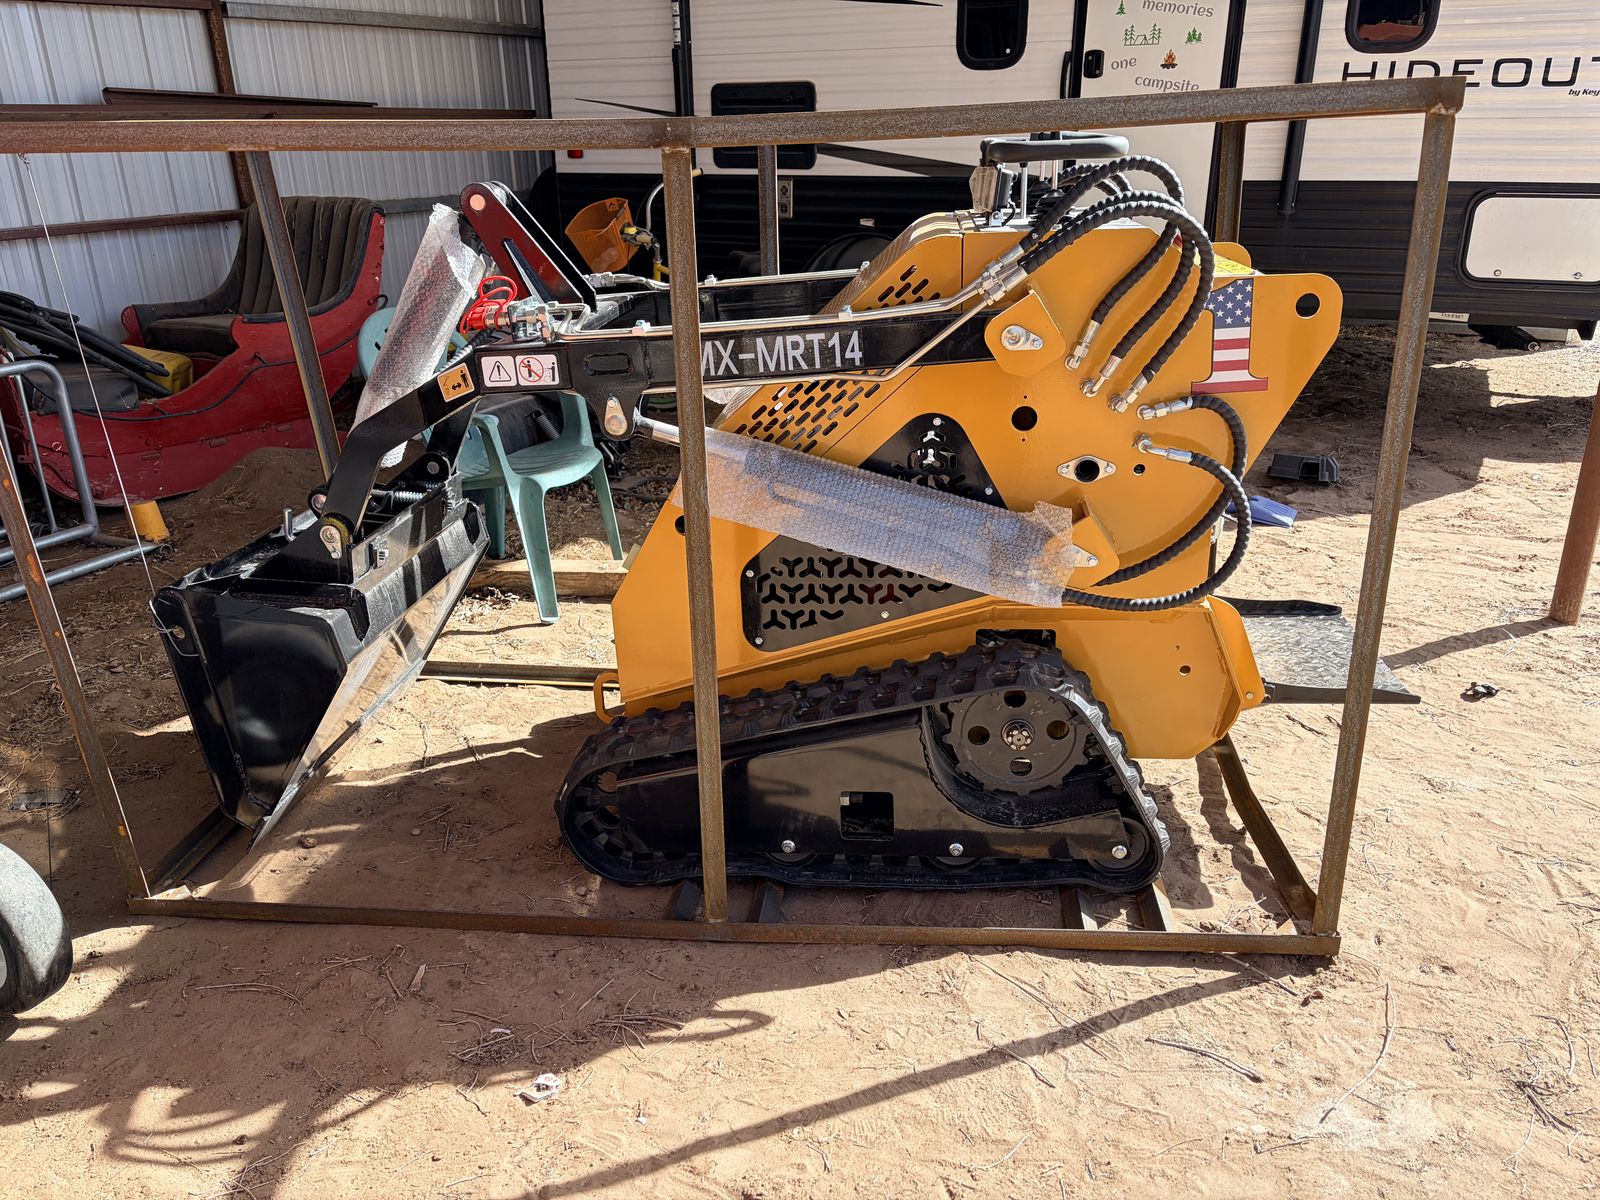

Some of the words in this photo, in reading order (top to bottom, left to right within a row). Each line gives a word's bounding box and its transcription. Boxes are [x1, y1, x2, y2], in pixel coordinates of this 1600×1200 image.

[1142, 0, 1214, 17] memories
[1111, 57, 1137, 70] one
[1342, 57, 1600, 88] HIDEOU
[1134, 76, 1200, 92] campsite
[1568, 88, 1581, 97] by
